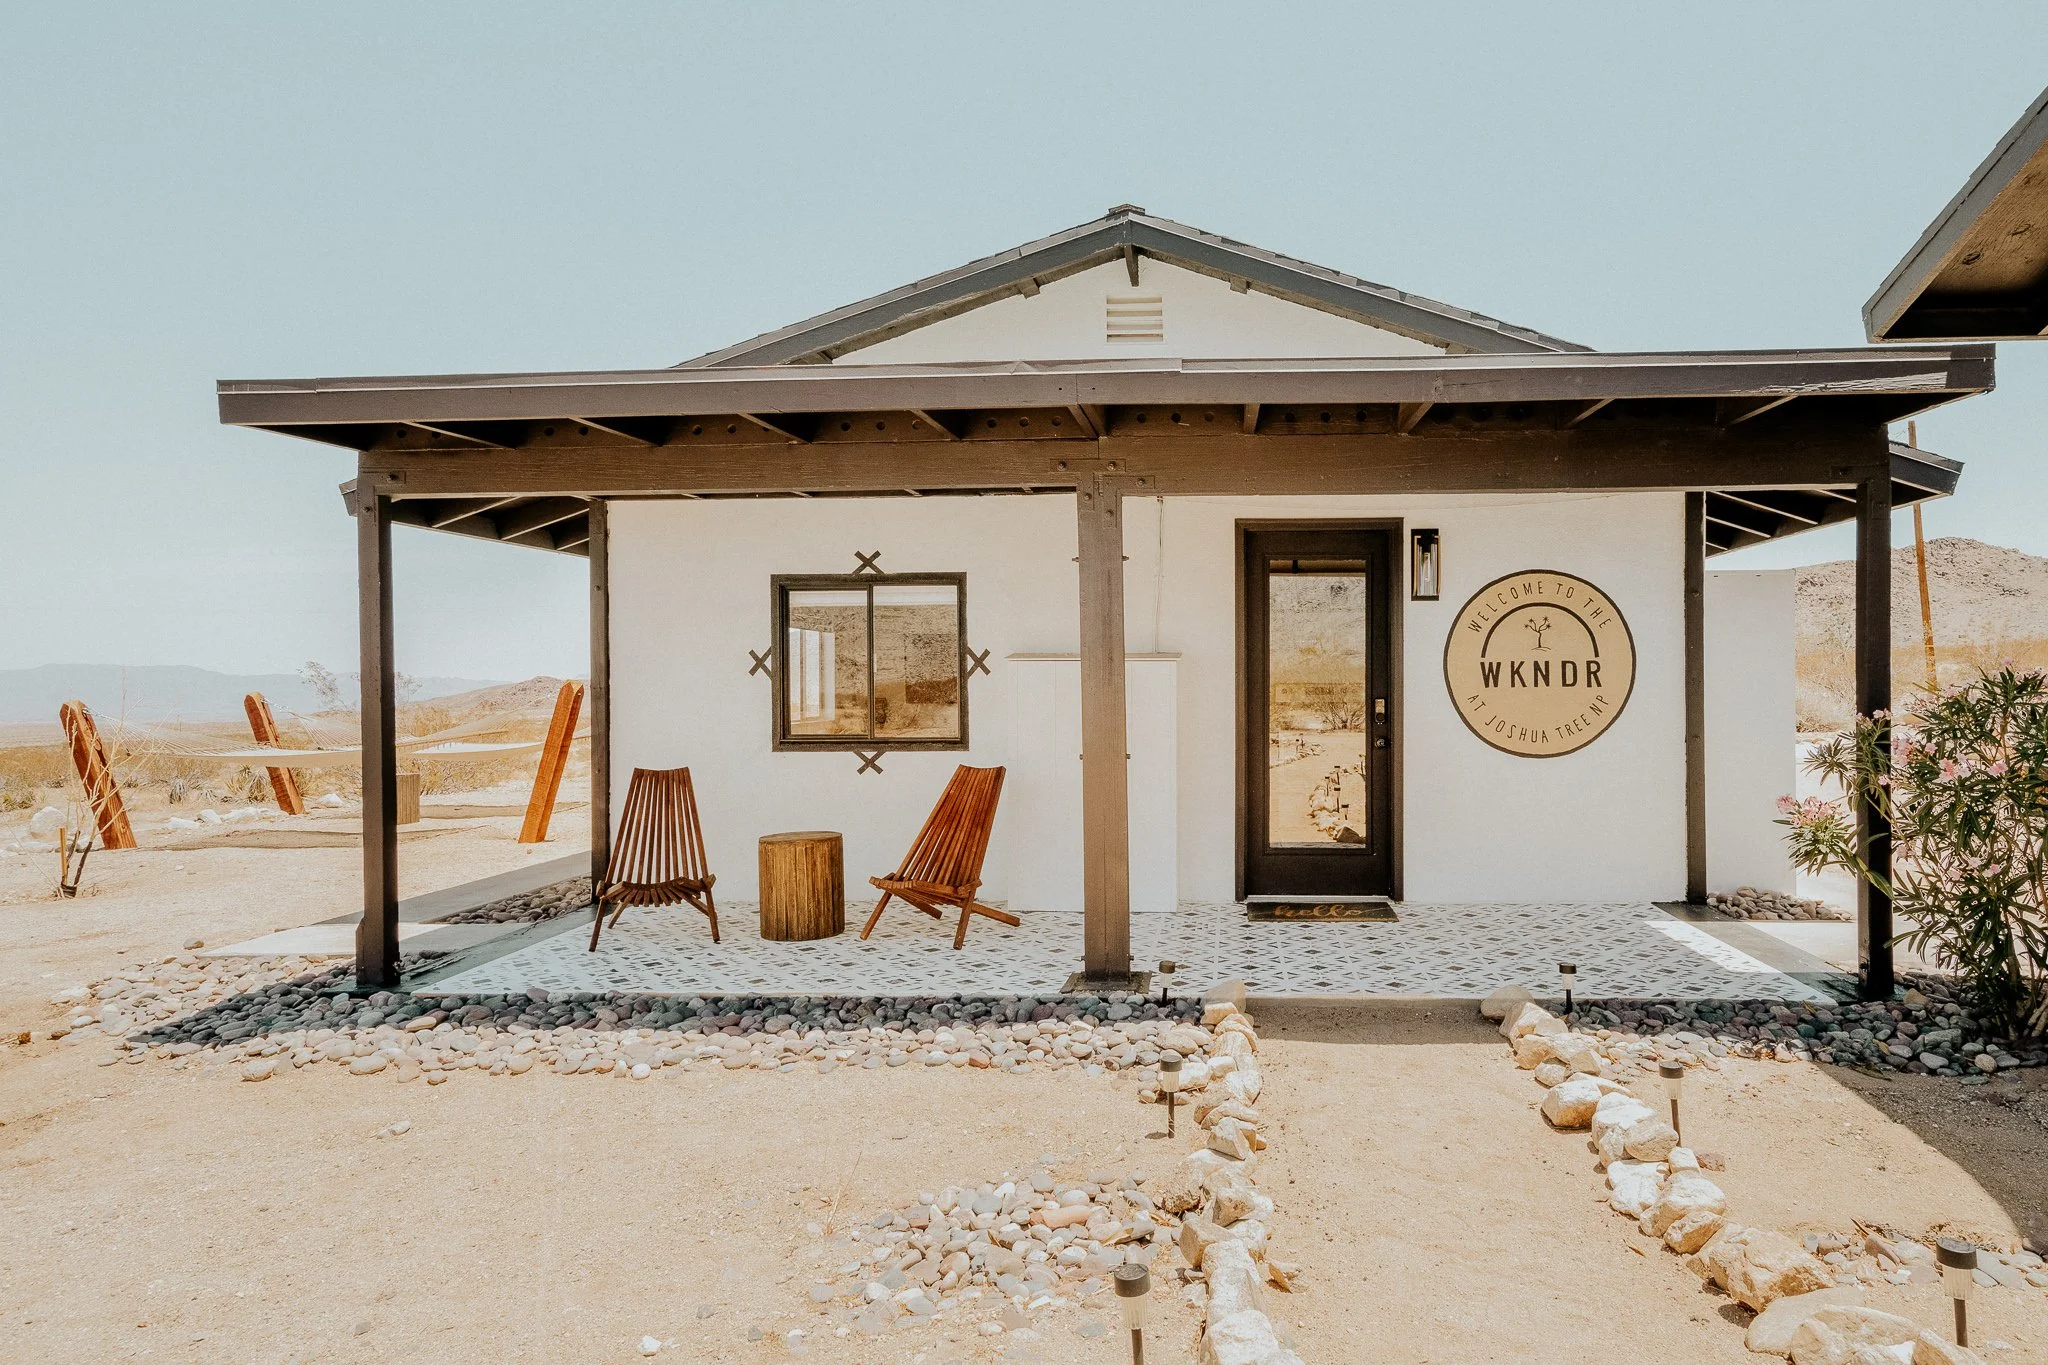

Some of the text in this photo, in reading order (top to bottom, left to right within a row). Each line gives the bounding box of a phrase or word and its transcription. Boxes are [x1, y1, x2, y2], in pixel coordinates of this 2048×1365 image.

[1468, 581, 1612, 633] WELCOME TO THE
[1480, 660, 1602, 688] WKNDR
[1467, 694, 1609, 743] AT JOSHUA TREE NP
[1273, 904, 1365, 917] hello
